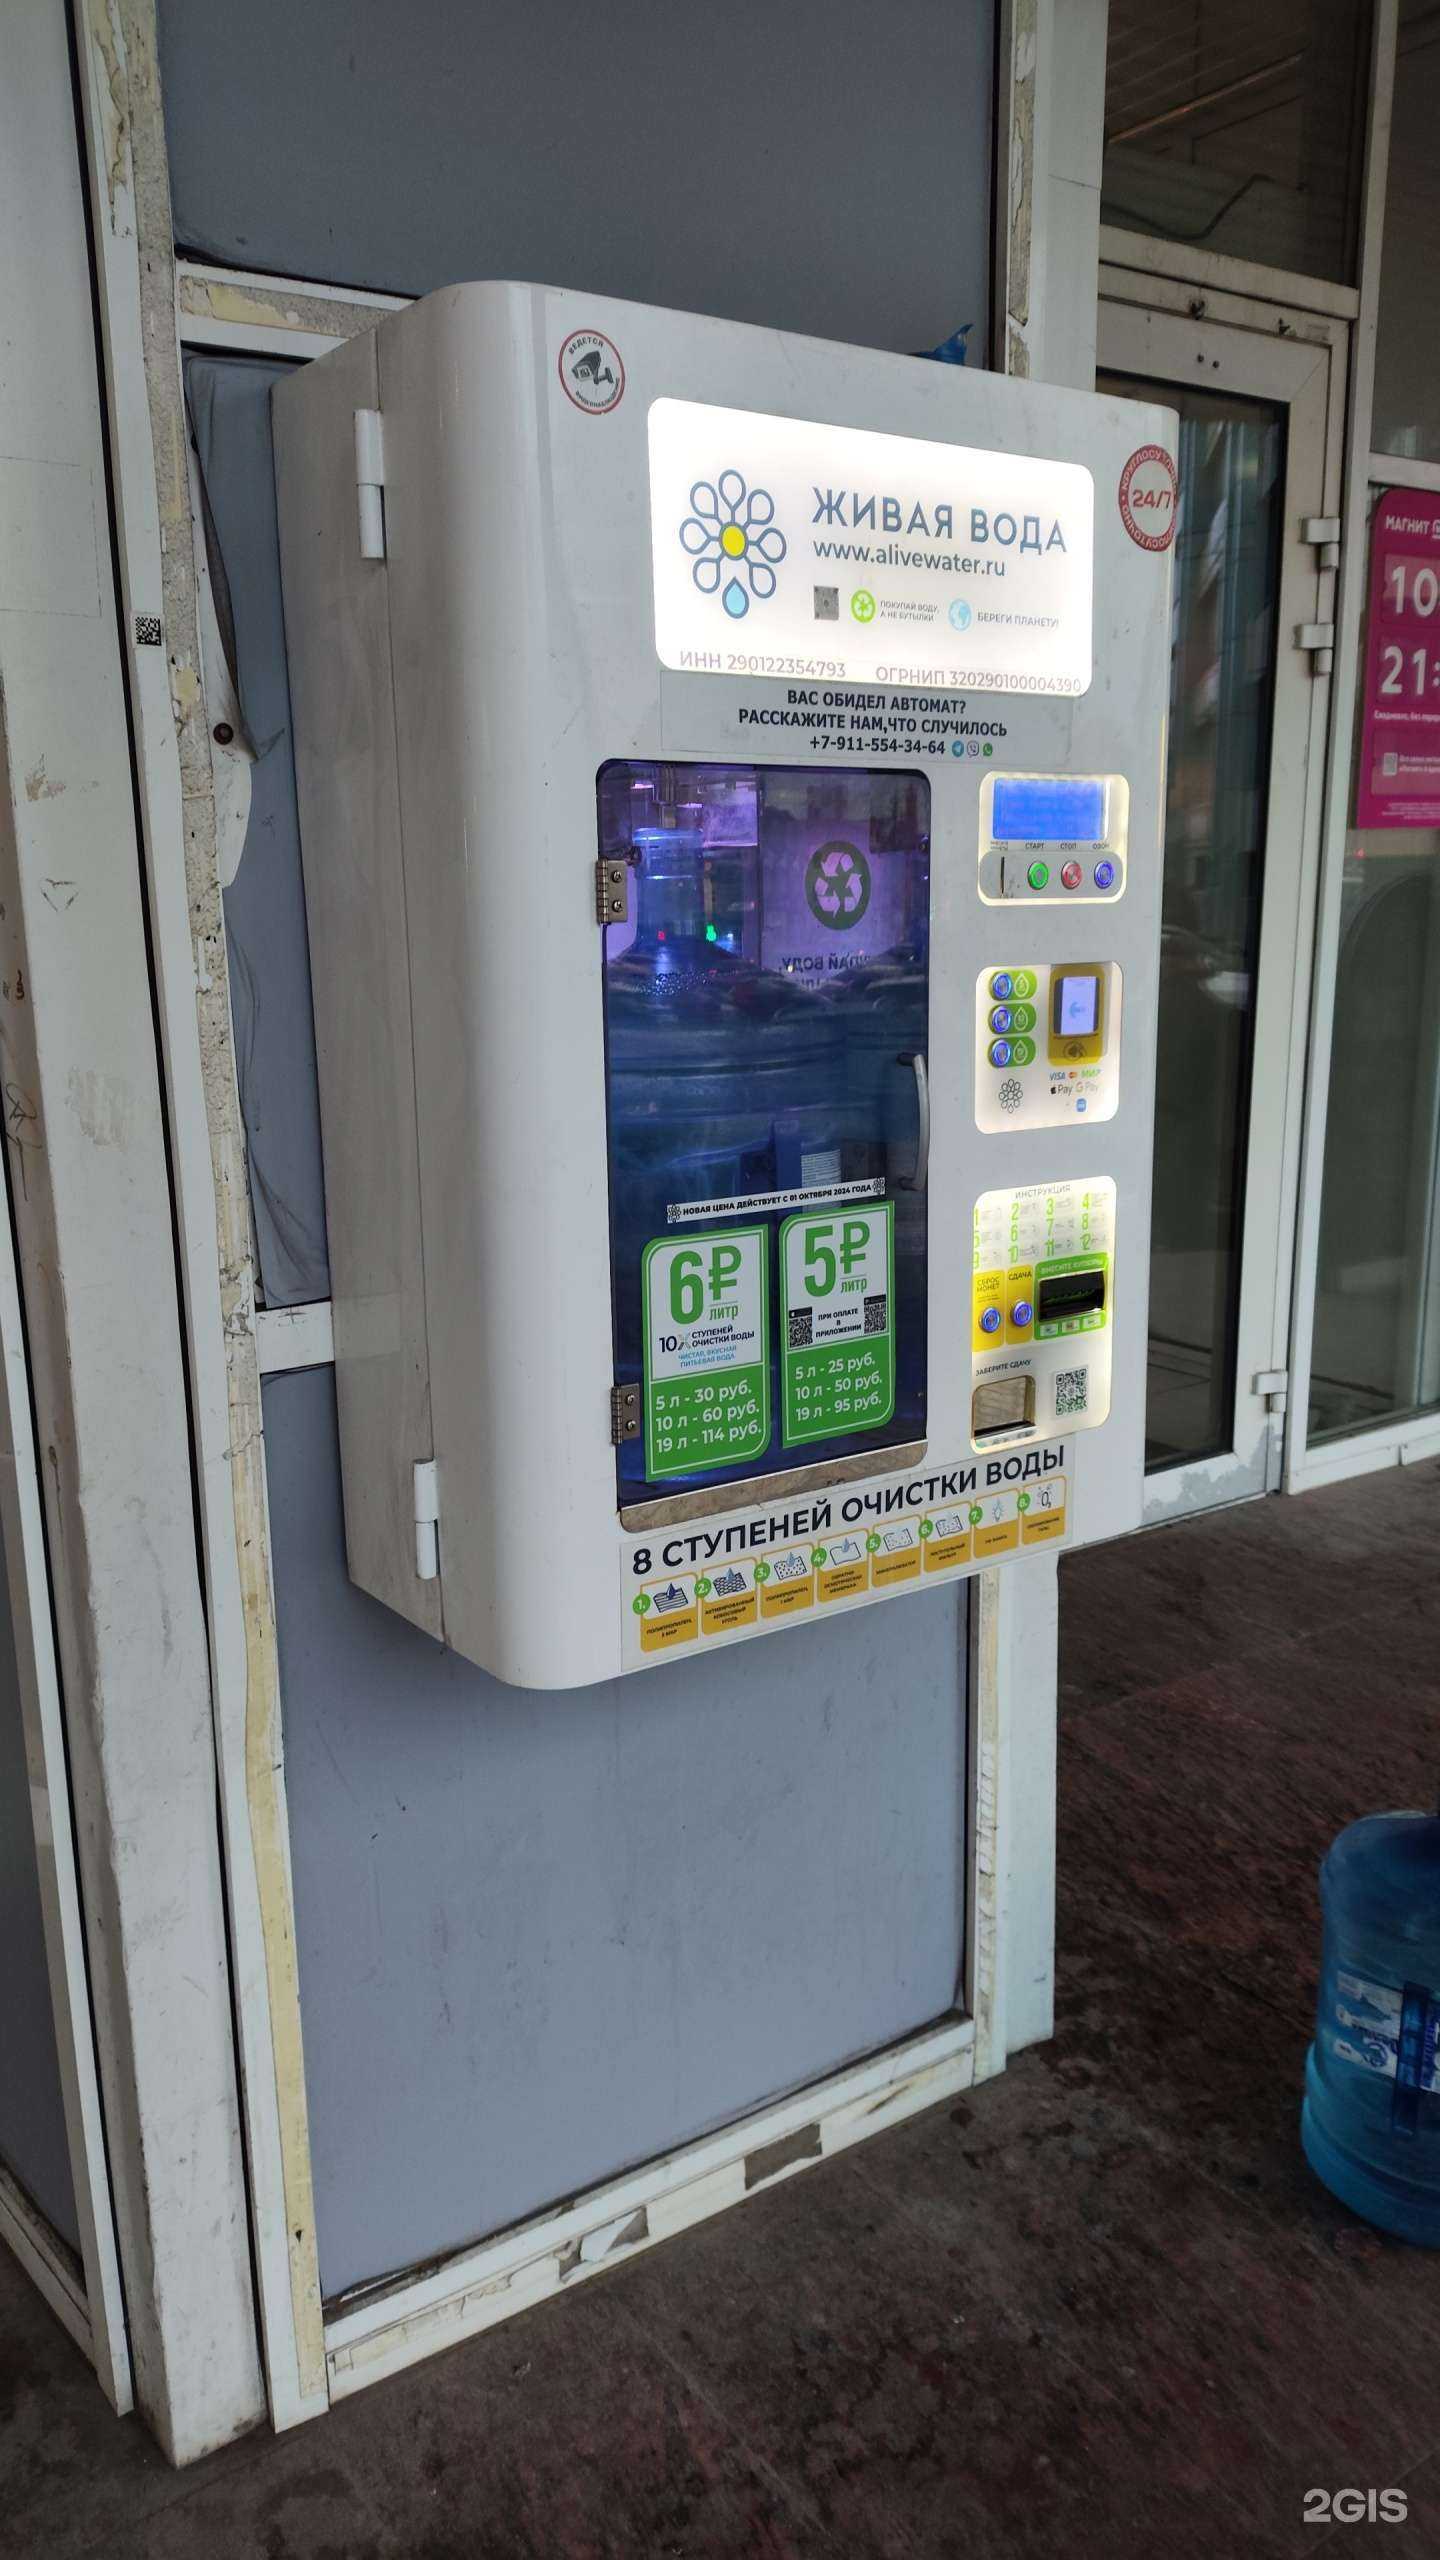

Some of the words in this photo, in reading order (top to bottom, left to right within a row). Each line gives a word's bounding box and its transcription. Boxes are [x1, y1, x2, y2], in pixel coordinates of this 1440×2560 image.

[1132, 489, 1172, 508] 24/7
[812, 486, 953, 539] ЖИВАЯ
[970, 508, 1068, 555] ВОДА
[1386, 514, 1430, 535] МАГНИТ
[813, 540, 1005, 577] www.alivewater.ru
[977, 612, 1012, 624] БЕРЕГИ
[679, 650, 722, 669] ИНН
[727, 655, 846, 678] 290122354793
[876, 666, 946, 686] ОГРНИП
[950, 670, 1082, 692] 320290100004390
[787, 689, 819, 706] ВАС
[822, 692, 887, 711] ОБИДЕЛ
[890, 696, 967, 715] АВТОМАТ?
[738, 708, 846, 730] РАССКАЖИТЕ
[921, 716, 1008, 737] СЛУЧИЛОСЬ
[809, 735, 946, 756] +7-911-554-34-64
[1025, 842, 1045, 850] СТАРТ
[1050, 1072, 1066, 1080] VISA
[1057, 1084, 1072, 1096] Pay
[682, 1206, 711, 1215] НОВАЯ
[712, 1202, 736, 1212] ЦЕНА
[736, 1196, 781, 1210] ДЕЙСТВУЕТ
[790, 1194, 798, 1202] 01
[798, 1189, 832, 1200] ОКТЯБРЯ
[834, 1187, 851, 1196] 2024
[852, 1184, 872, 1193] ГОДА
[1015, 1184, 1071, 1199] ИНСТРУКЦИЯ
[1046, 1198, 1054, 1216] 3
[1082, 1192, 1090, 1210] 4
[1011, 1202, 1019, 1220] 2
[1046, 1218, 1054, 1236] 7
[1082, 1213, 1089, 1230] 8
[1010, 1225, 1018, 1242] 6
[1008, 1271, 1032, 1281] СДАЧА
[832, 1308, 858, 1318] ОПЛАТЕ
[692, 1324, 734, 1338] СТУПЕНЕЙ
[692, 1336, 730, 1348] ОЧИСТКИ
[730, 1330, 755, 1342] ВОДЫ
[816, 1324, 862, 1338] ПРИЛОЖЕНИИ
[795, 1366, 804, 1380] 5
[807, 1366, 816, 1378] л
[828, 1358, 844, 1374] 25
[848, 1352, 876, 1372] руб.
[976, 1362, 1009, 1376] ЗАБЕРИТЕ
[1009, 1359, 1032, 1370] СДАЧУ
[796, 1386, 810, 1400] 10
[813, 1386, 822, 1398] л
[834, 1378, 852, 1392] 50
[855, 1370, 882, 1392] руб.
[656, 1396, 665, 1410] 5
[670, 1396, 680, 1408] л
[694, 1387, 714, 1403] 30
[719, 1380, 752, 1402] руб.
[656, 1416, 672, 1432] 10
[677, 1416, 688, 1428] л
[703, 1406, 722, 1422] 60
[728, 1398, 760, 1422] руб.
[796, 1407, 810, 1421] 19
[813, 1406, 822, 1418] л
[834, 1398, 850, 1413] 95
[854, 1391, 882, 1412] руб.
[656, 1438, 672, 1453] 19
[677, 1437, 688, 1450] л
[702, 1427, 724, 1444] 114
[729, 1420, 762, 1442] руб.
[632, 1548, 652, 1576] 8
[661, 1498, 833, 1567] СТУПЕНЕЙ
[840, 1468, 978, 1522] ОЧИСТКИ
[986, 1444, 1065, 1490] ВОДЫ
